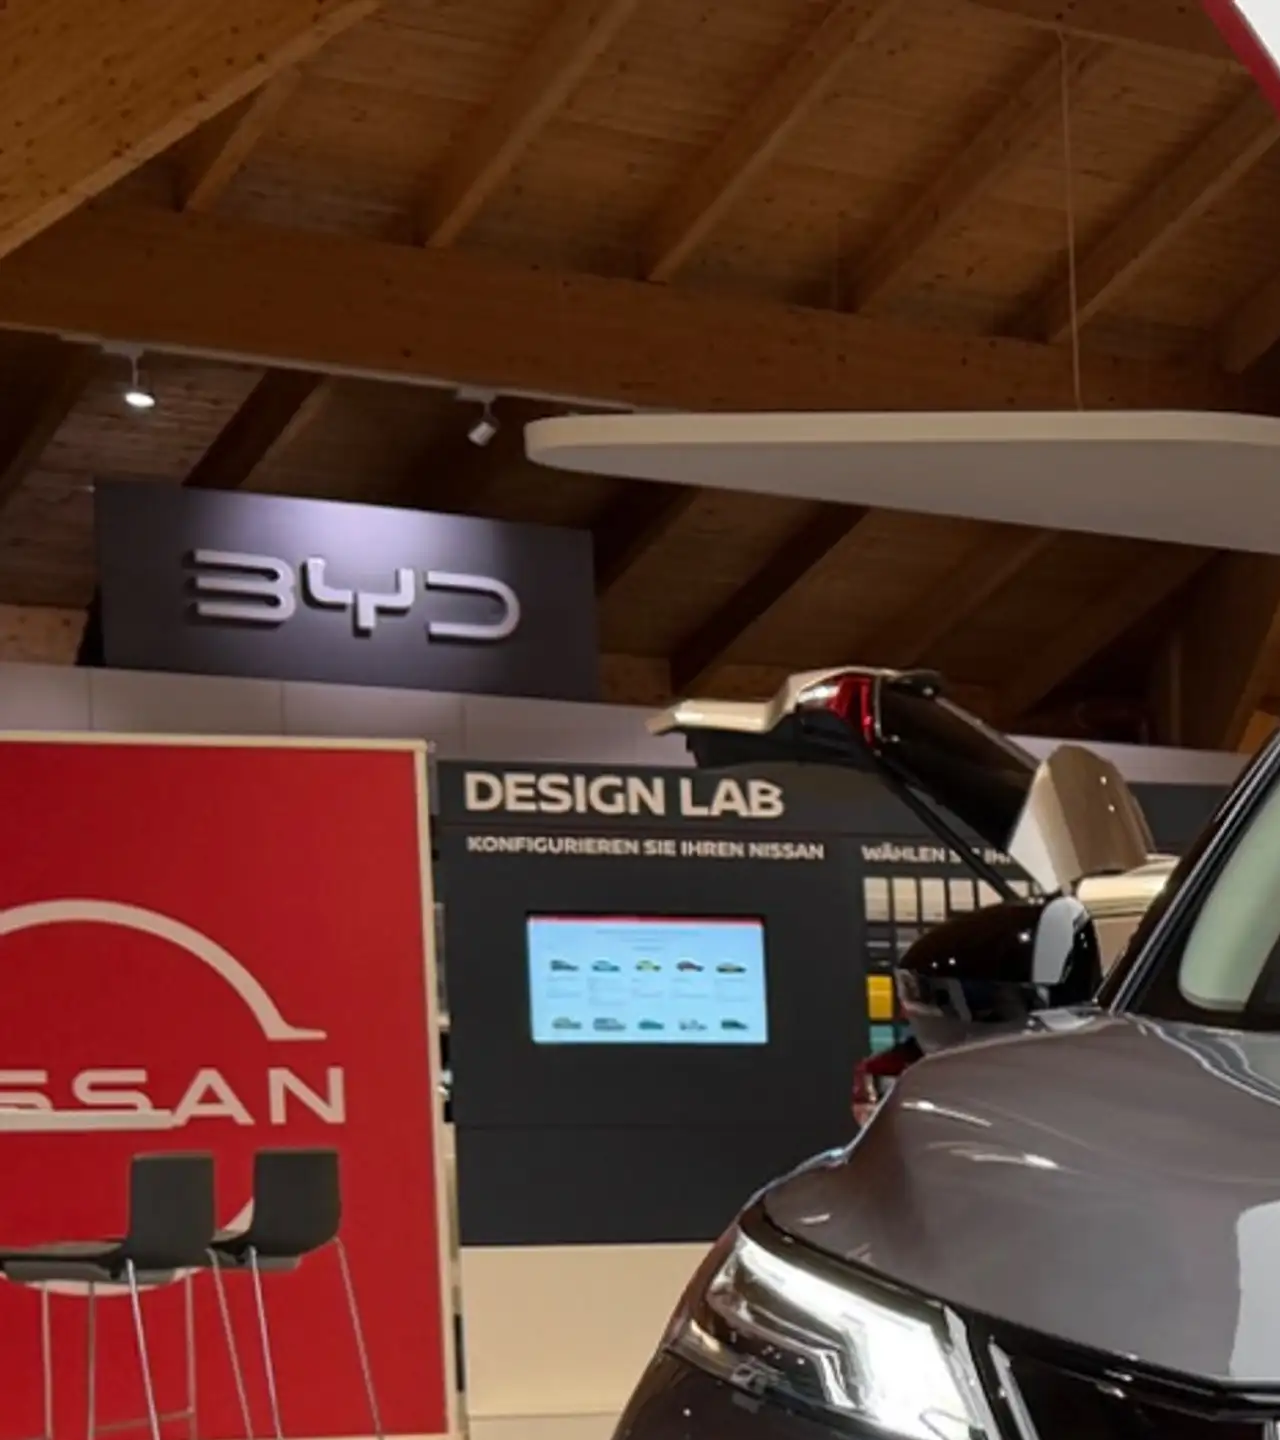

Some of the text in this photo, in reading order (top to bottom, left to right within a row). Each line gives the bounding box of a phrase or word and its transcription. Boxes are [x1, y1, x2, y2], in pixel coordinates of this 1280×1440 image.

[194, 548, 520, 640] BYD
[464, 771, 785, 818] DESIGN LAB
[466, 835, 825, 861] KONFIGURIEREN SIE IHREN NISSAN
